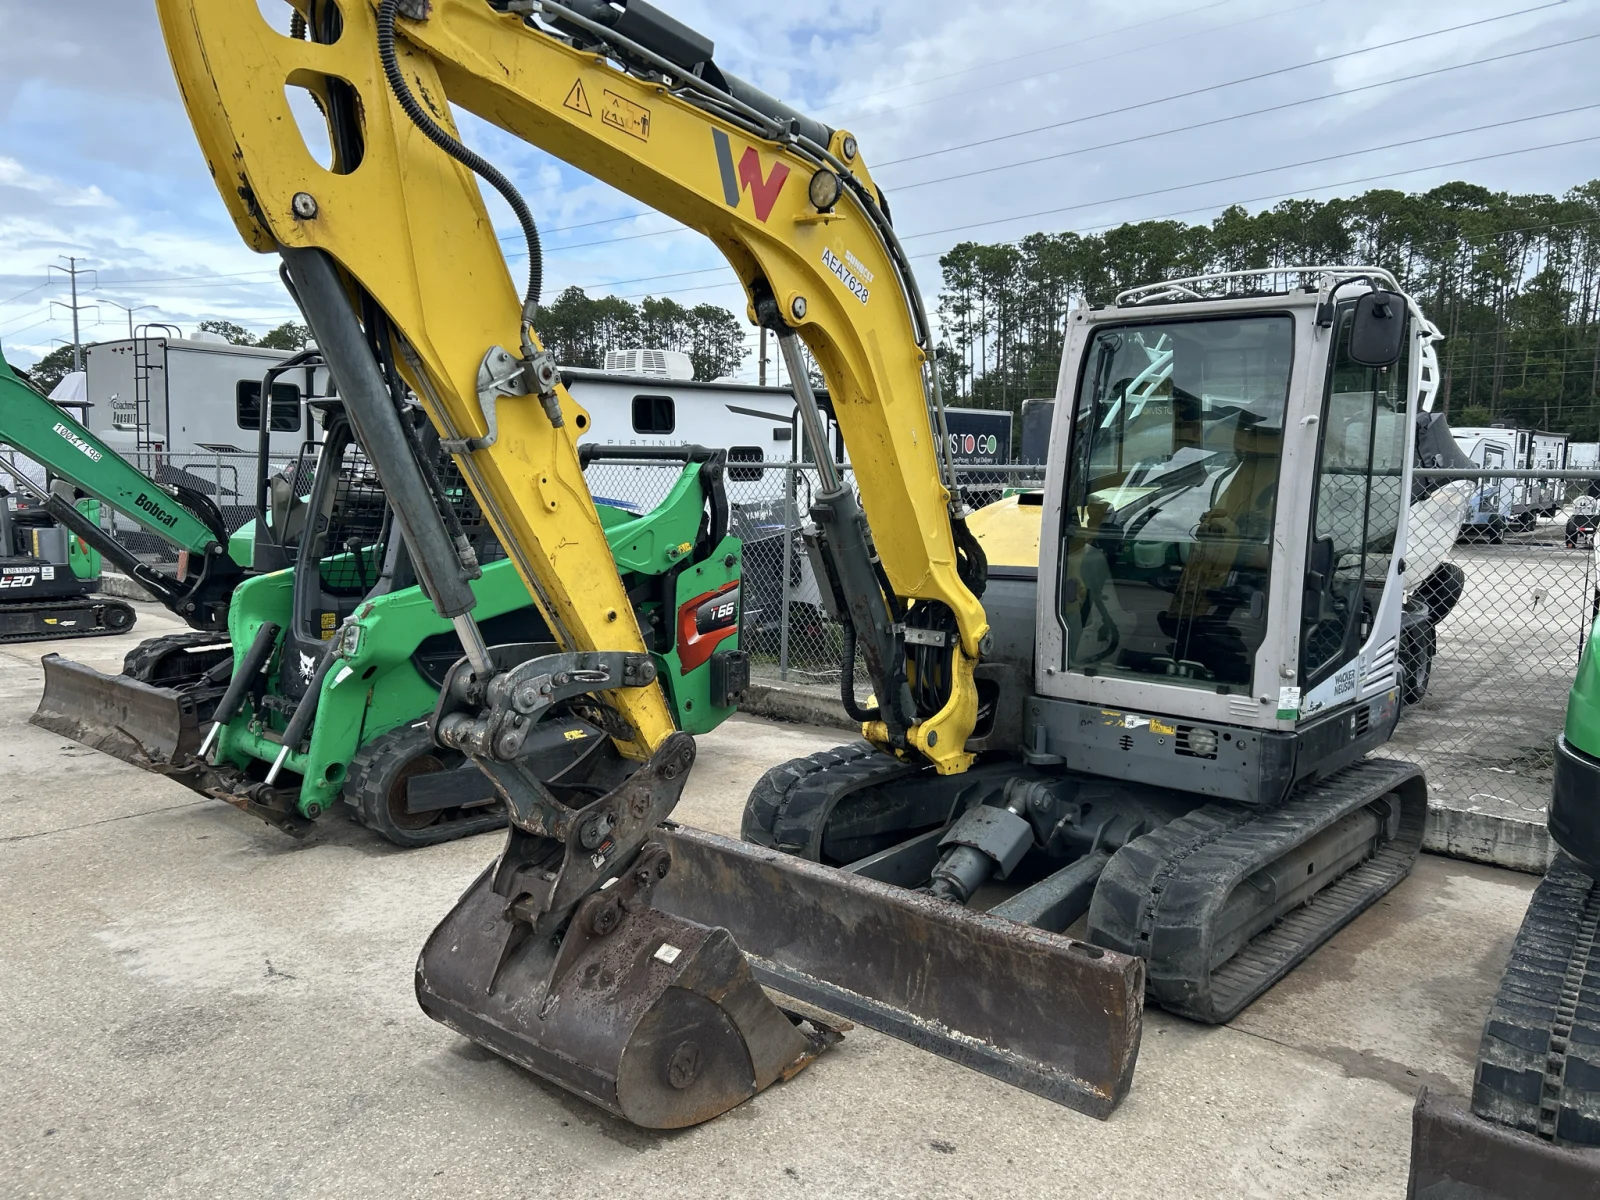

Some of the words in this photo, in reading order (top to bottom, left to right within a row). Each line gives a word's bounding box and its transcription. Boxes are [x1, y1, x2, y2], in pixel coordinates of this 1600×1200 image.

[821, 249, 869, 304] AEA7628
[112, 400, 138, 410] Coachme
[112, 411, 137, 424] PURSUIT
[55, 424, 101, 461] 10047198
[960, 433, 976, 454] TO
[977, 433, 997, 454] GO
[134, 493, 179, 528] Bobcat
[0, 575, 35, 588] E20
[711, 602, 735, 620] T66
[1334, 669, 1356, 685] WACKER
[1334, 680, 1355, 696] NEUSON
